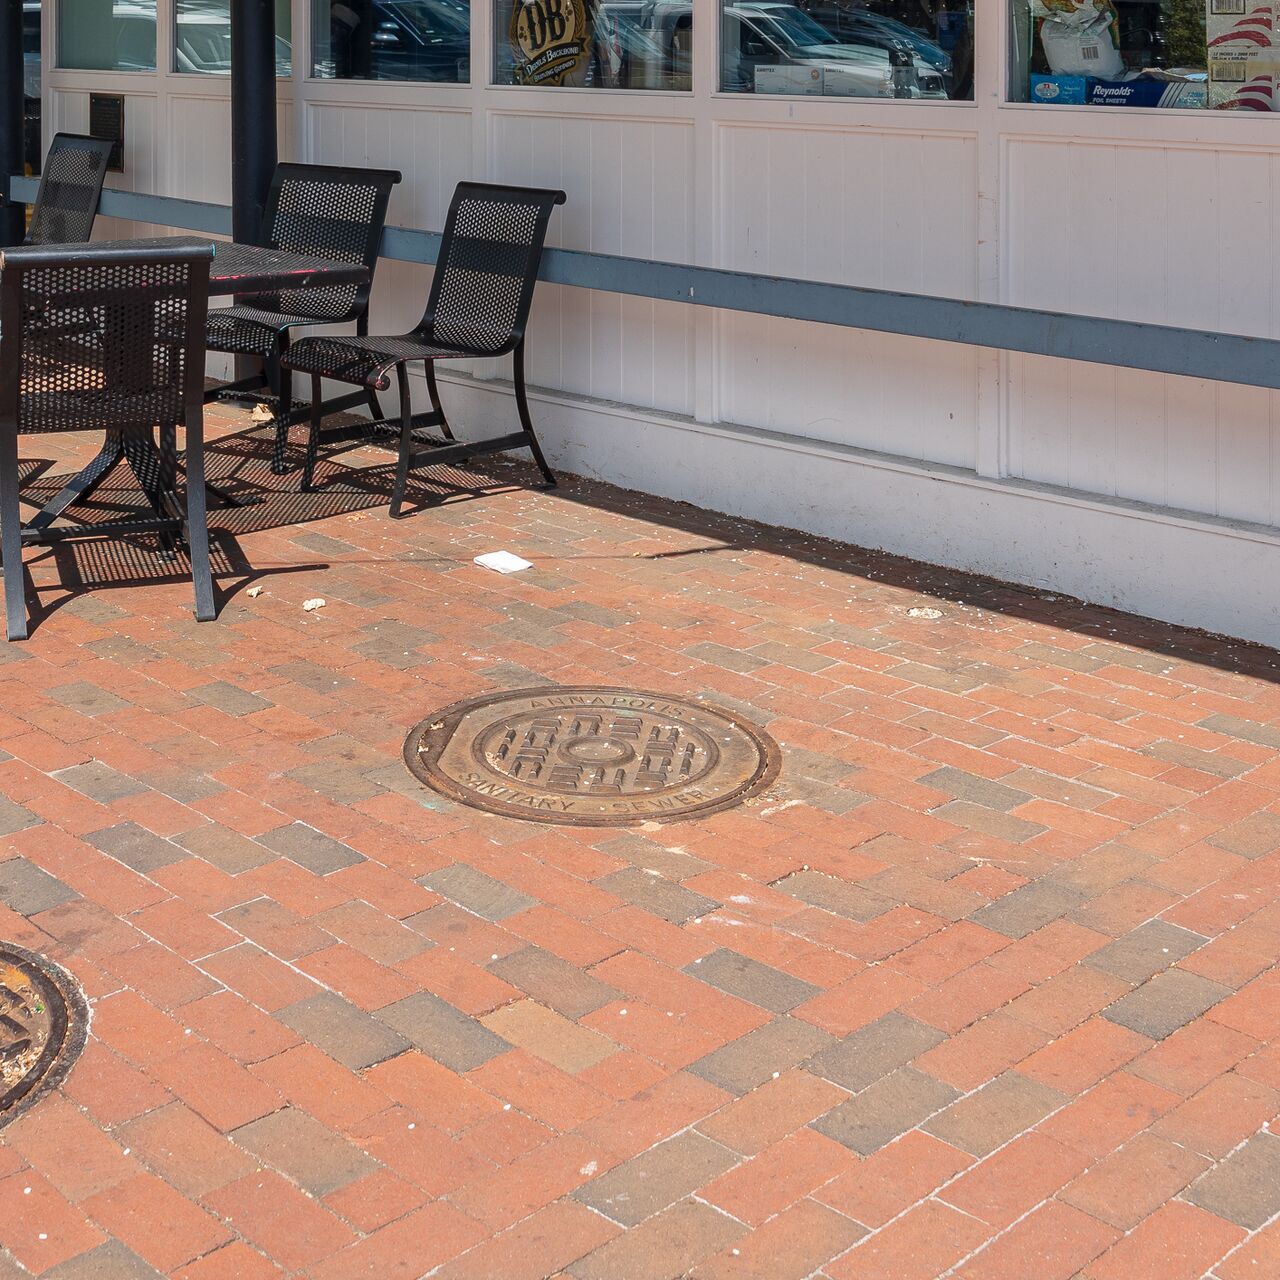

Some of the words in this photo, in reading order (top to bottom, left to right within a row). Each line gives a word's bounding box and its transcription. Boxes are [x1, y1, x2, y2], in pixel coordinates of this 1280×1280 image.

[1092, 85, 1132, 98] Reynolds
[530, 694, 686, 718] ANNAPOLIS
[459, 772, 576, 812] SANITARY
[611, 788, 712, 814] SEWER
